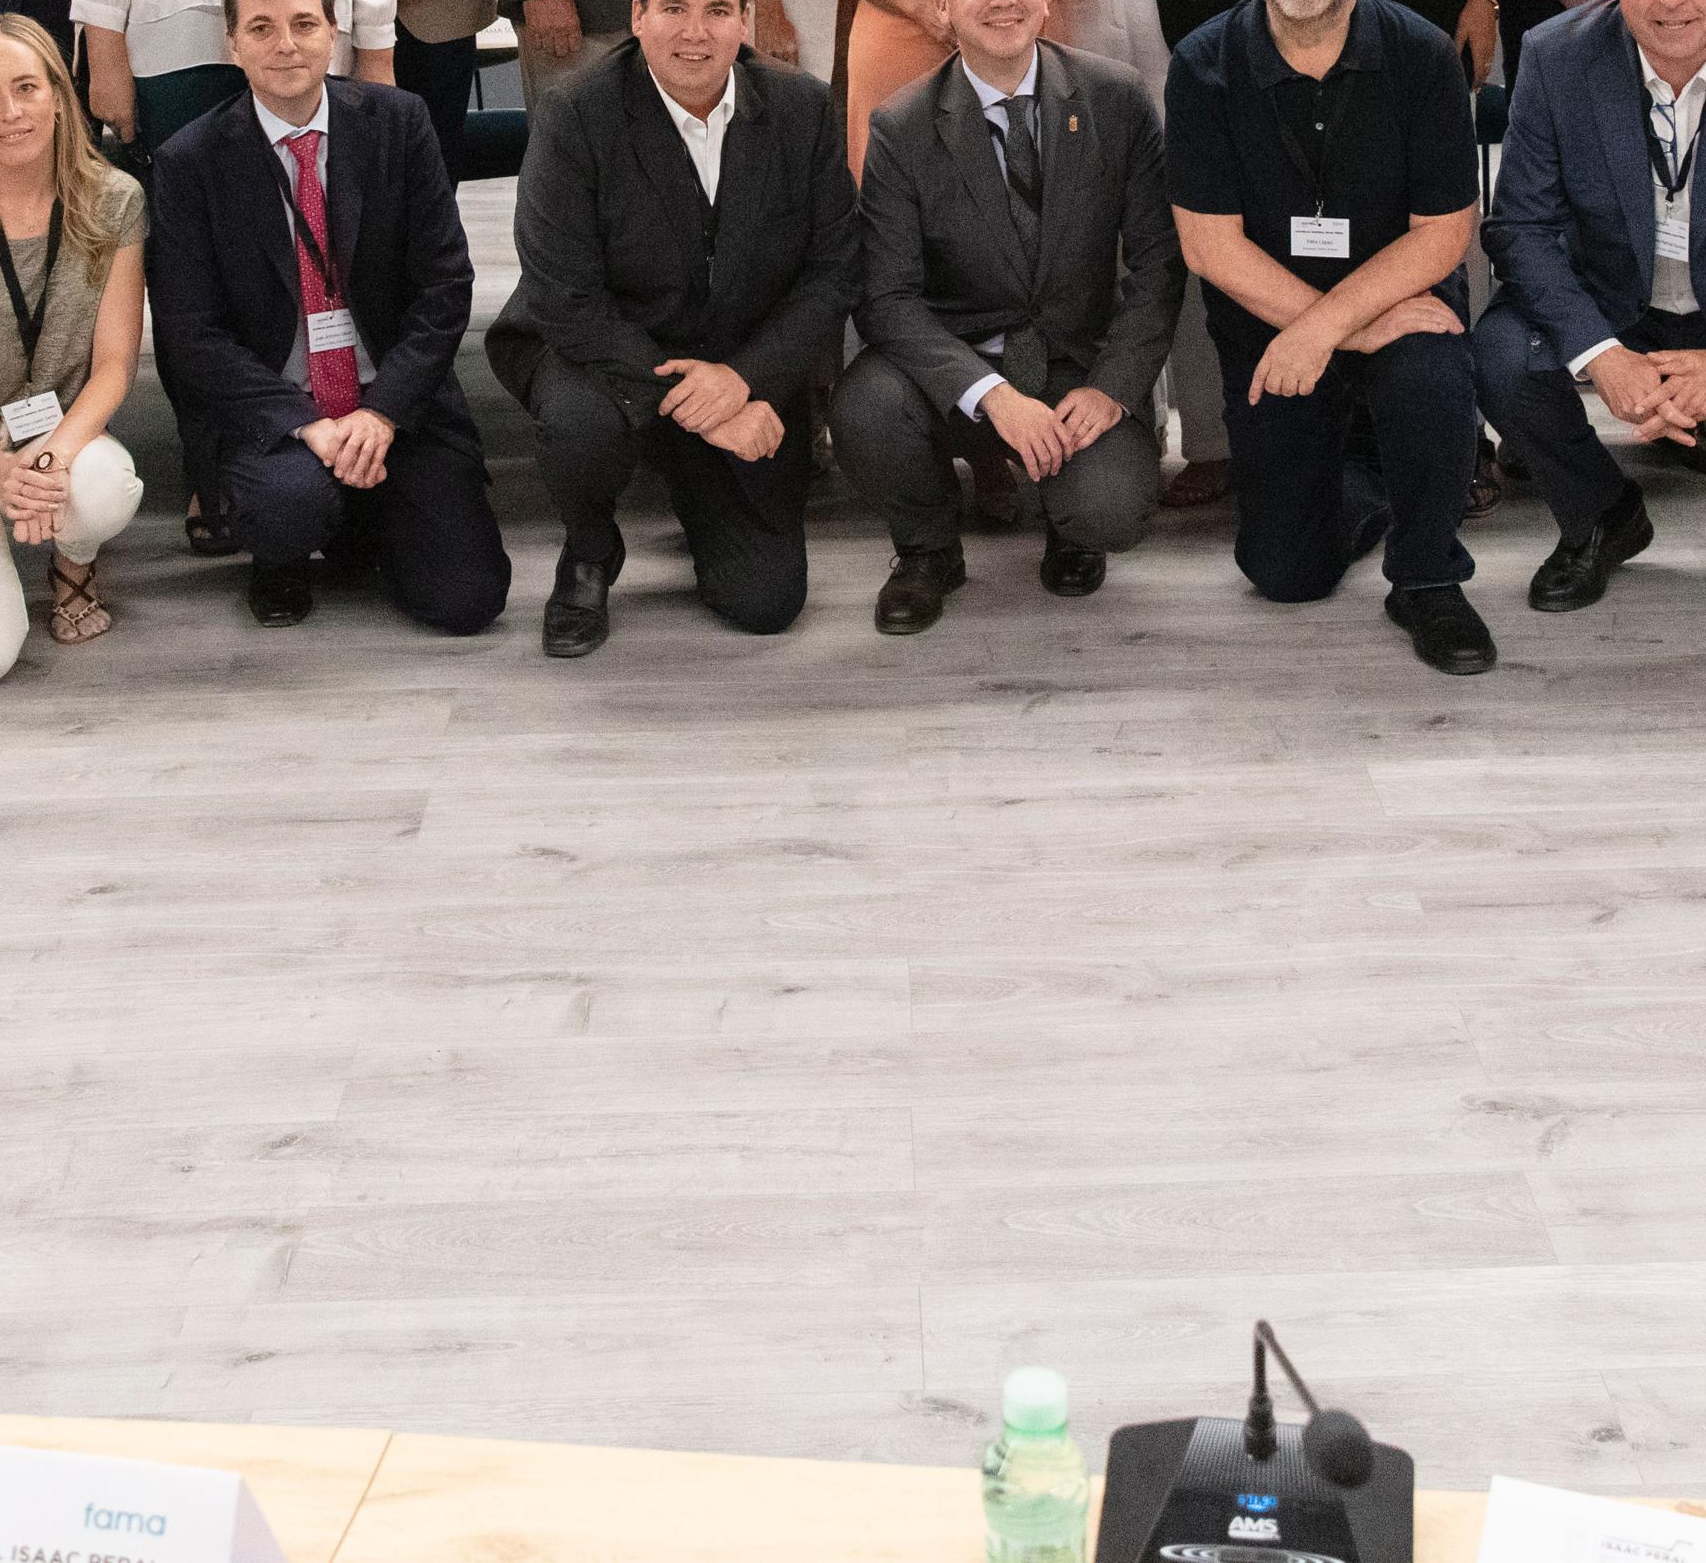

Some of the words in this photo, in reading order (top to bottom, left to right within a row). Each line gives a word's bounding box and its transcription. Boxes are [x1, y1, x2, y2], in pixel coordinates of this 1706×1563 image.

[83, 1502, 168, 1537] fama
[1228, 1516, 1279, 1534] AMS
[12, 1547, 81, 1563] ISAAC
